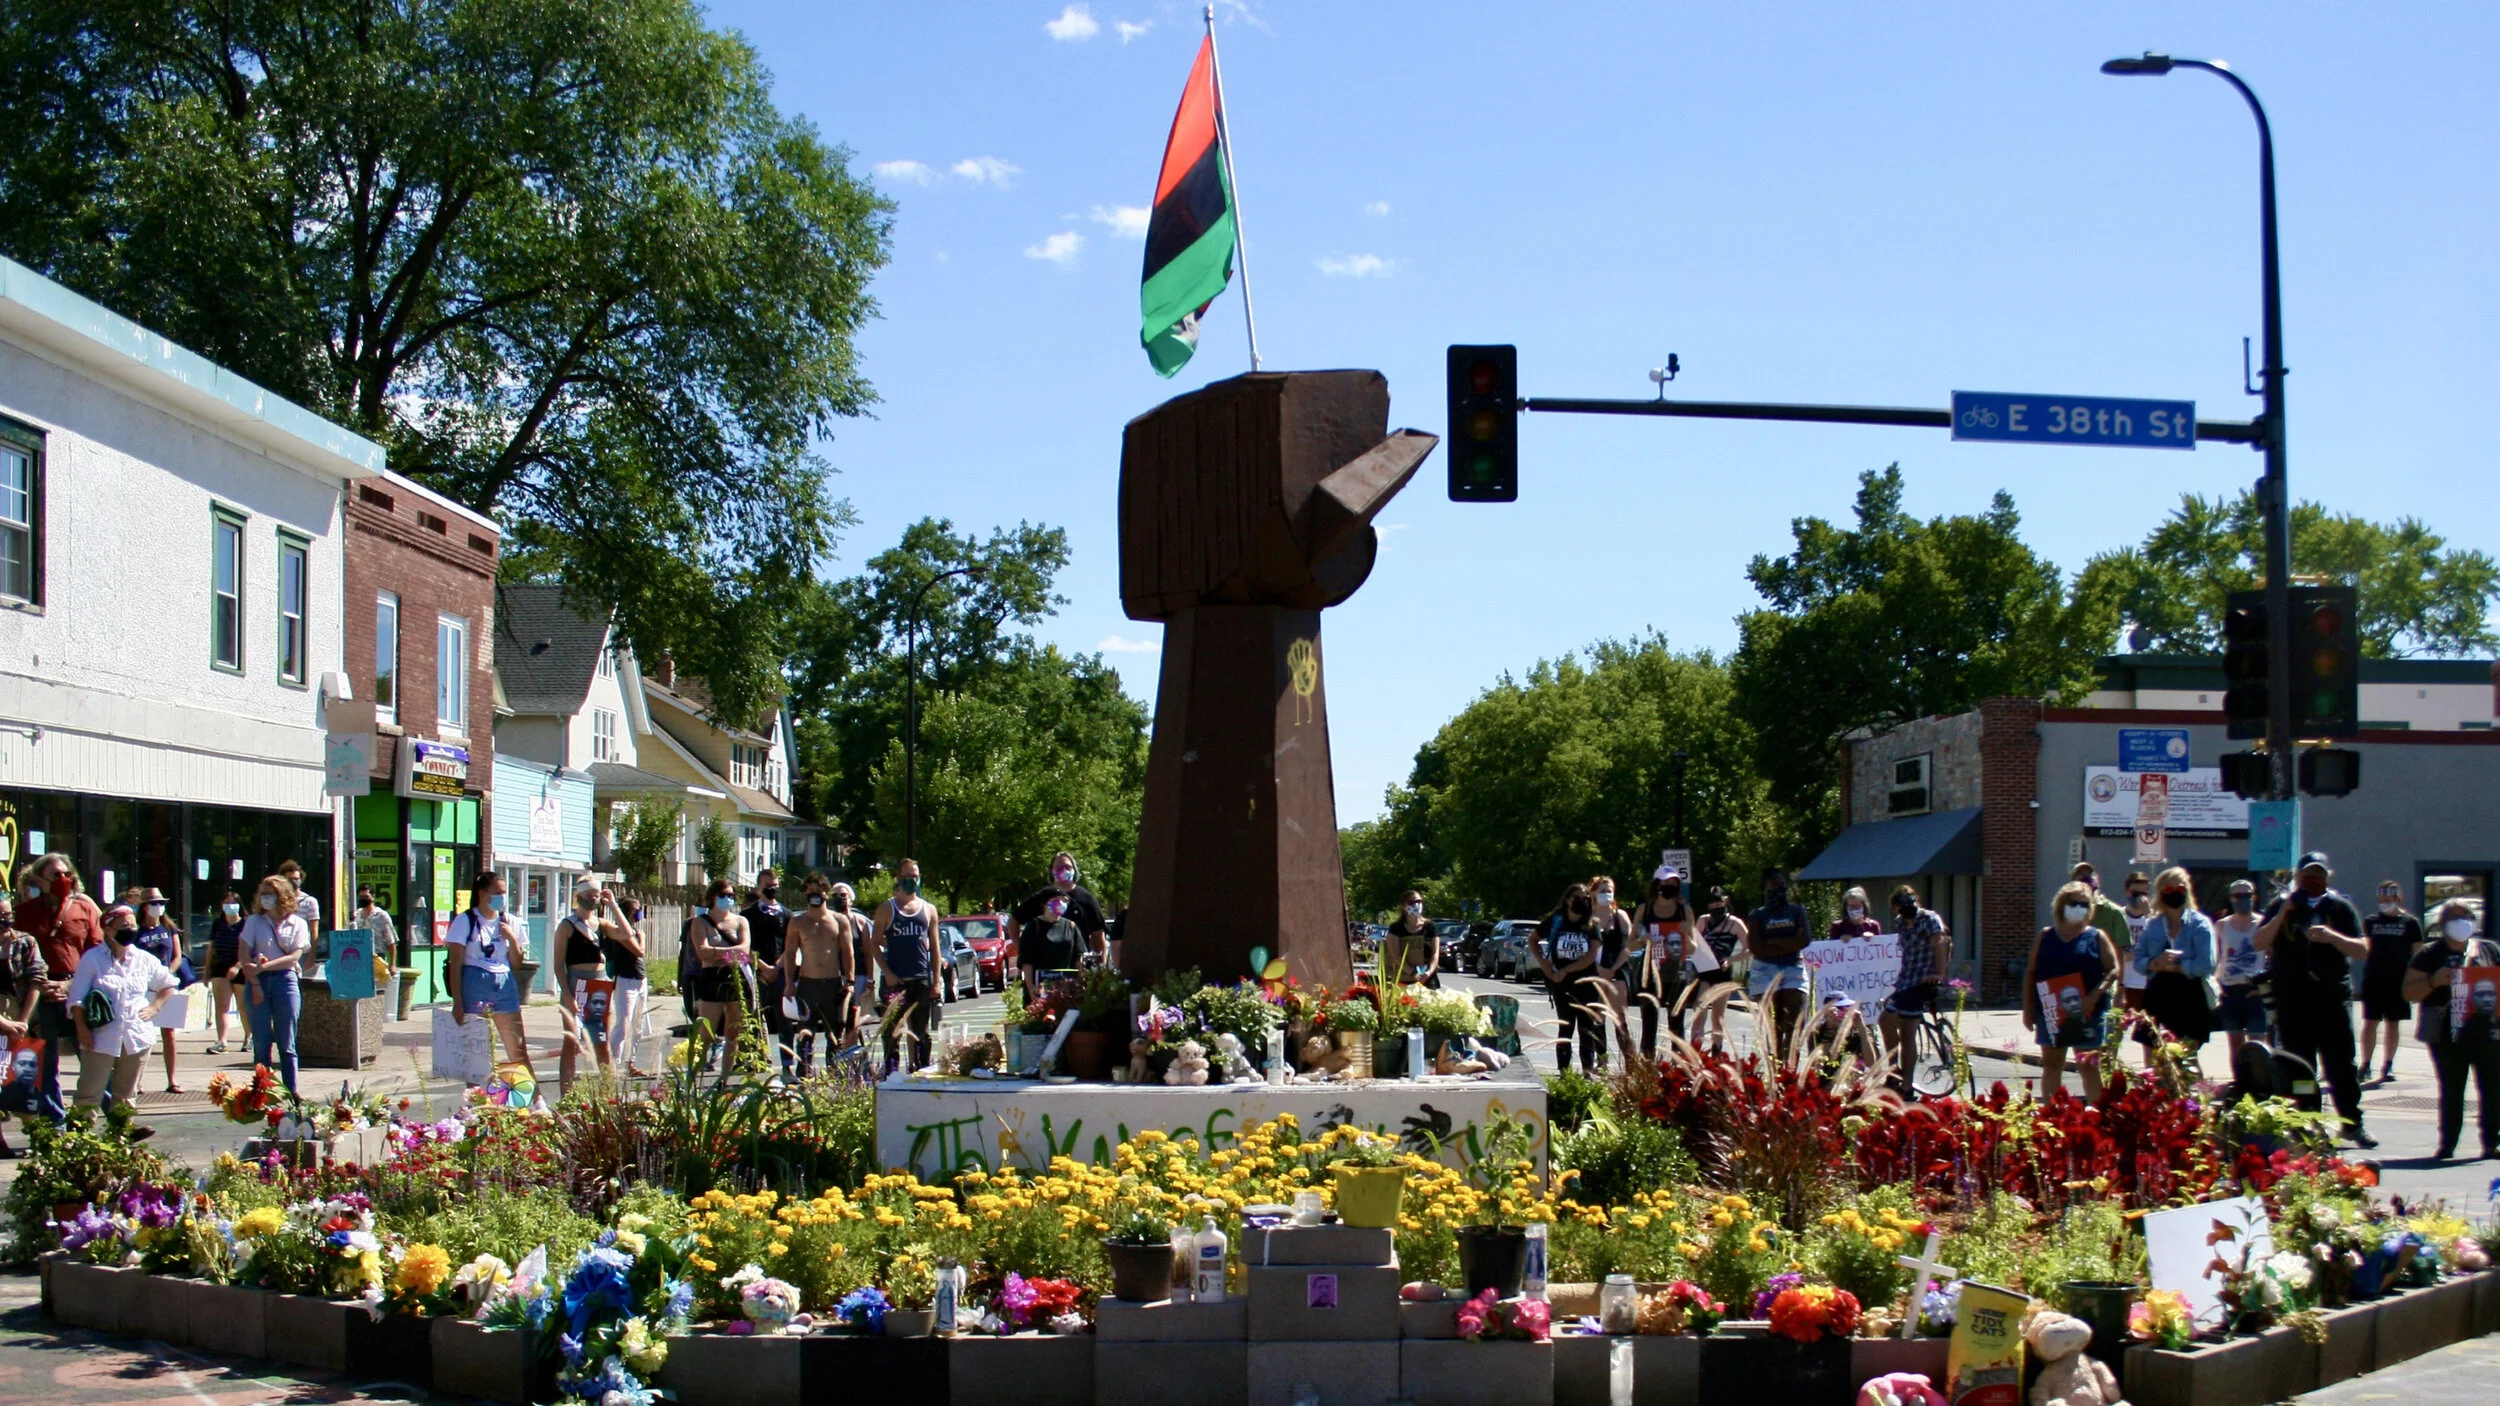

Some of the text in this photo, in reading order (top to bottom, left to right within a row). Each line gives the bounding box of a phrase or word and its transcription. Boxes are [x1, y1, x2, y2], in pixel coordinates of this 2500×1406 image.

[2009, 404, 2186, 438] E 38th St
[424, 761, 457, 776] CONNECT
[2169, 776, 2209, 791] Outreach
[355, 865, 397, 875] LIMITED
[1561, 941, 1584, 952] LIVES
[1803, 942, 1903, 965] KNOW JUSTICE
[1858, 969, 1897, 991] PEACE
[2036, 981, 2050, 996] DO
[2040, 993, 2058, 1010] YOU
[2450, 998, 2468, 1014] SEE
[2043, 1007, 2060, 1022] SEE
[1972, 1314, 2004, 1327] TIDY
[1970, 1324, 2007, 1337] CATS
